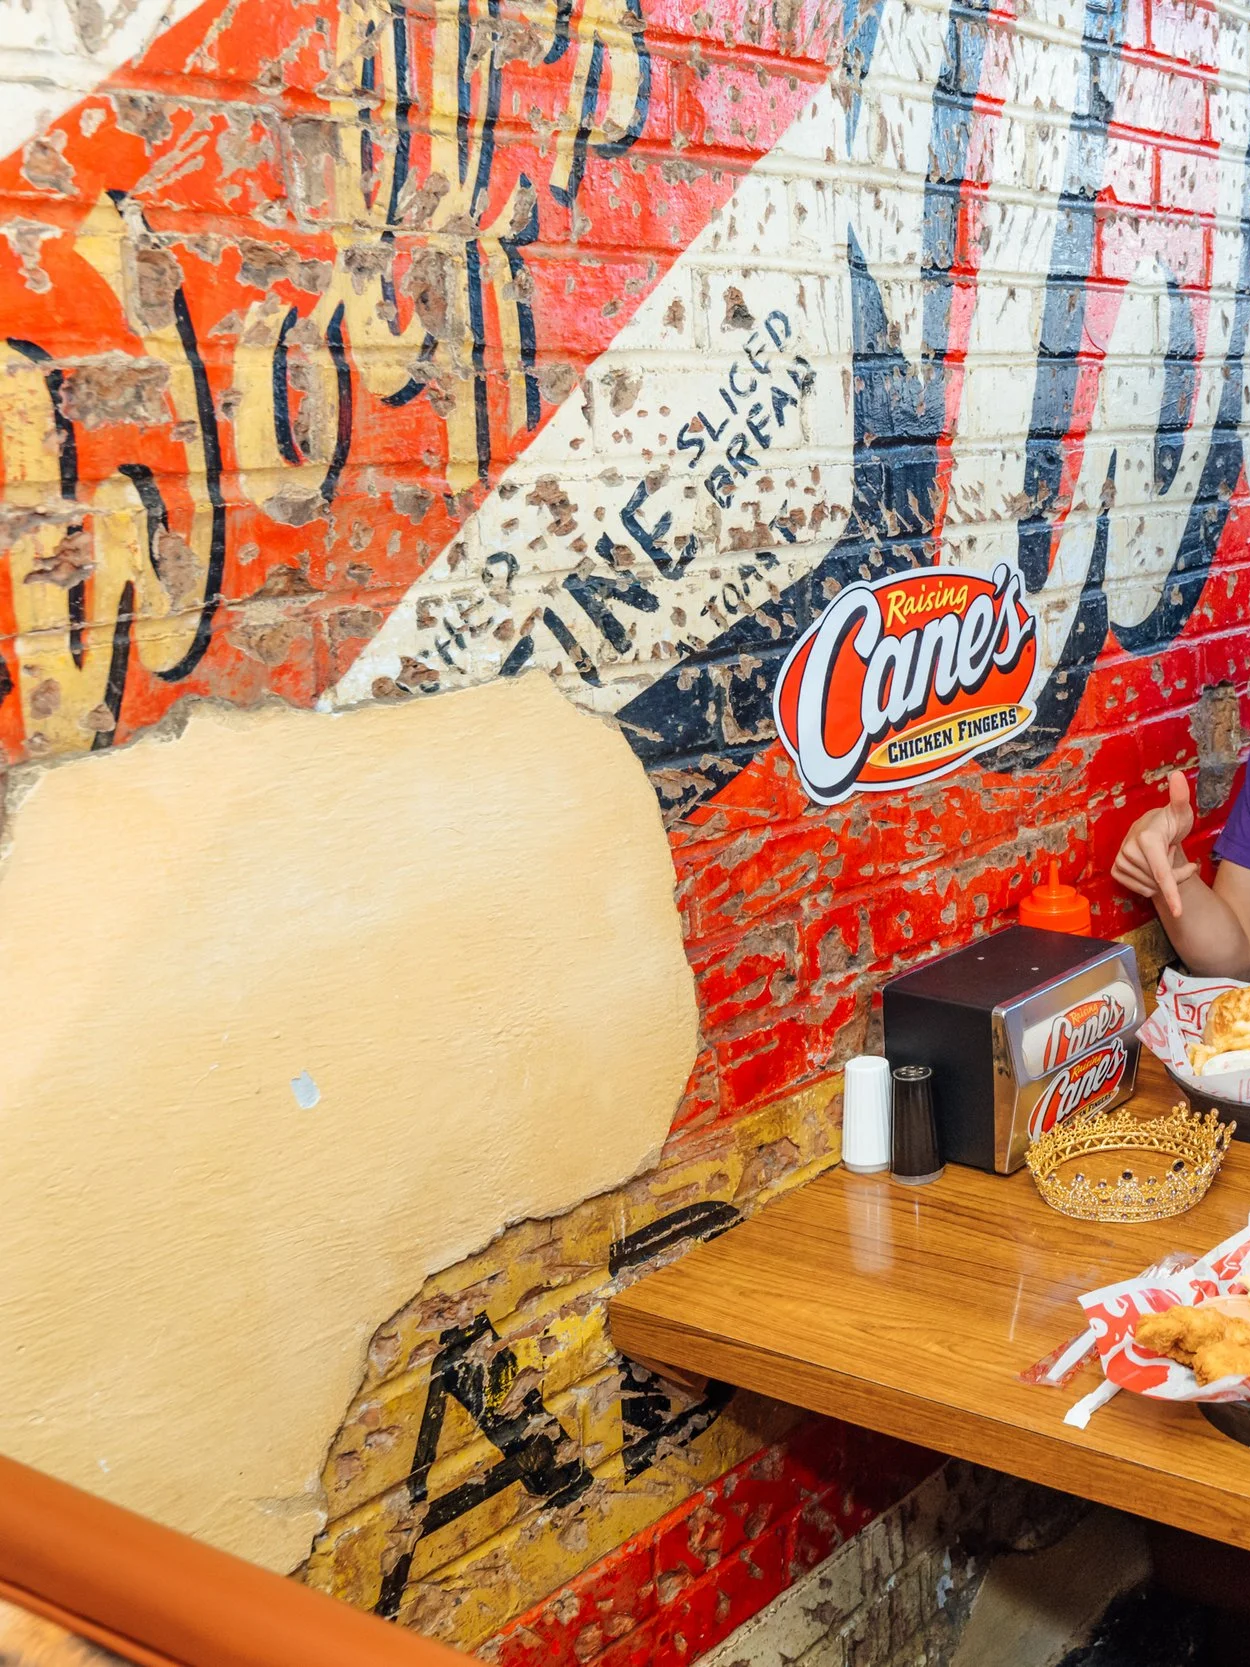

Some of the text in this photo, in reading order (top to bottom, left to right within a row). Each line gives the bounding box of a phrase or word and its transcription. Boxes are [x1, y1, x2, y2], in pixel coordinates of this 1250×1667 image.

[676, 309, 793, 468] SLICED
[499, 478, 699, 687] INE
[885, 580, 969, 629] Raising
[796, 562, 1036, 798] Cane's
[886, 706, 1018, 765] CHICKEN FINGERS
[1033, 1037, 1127, 1143] Cane's
